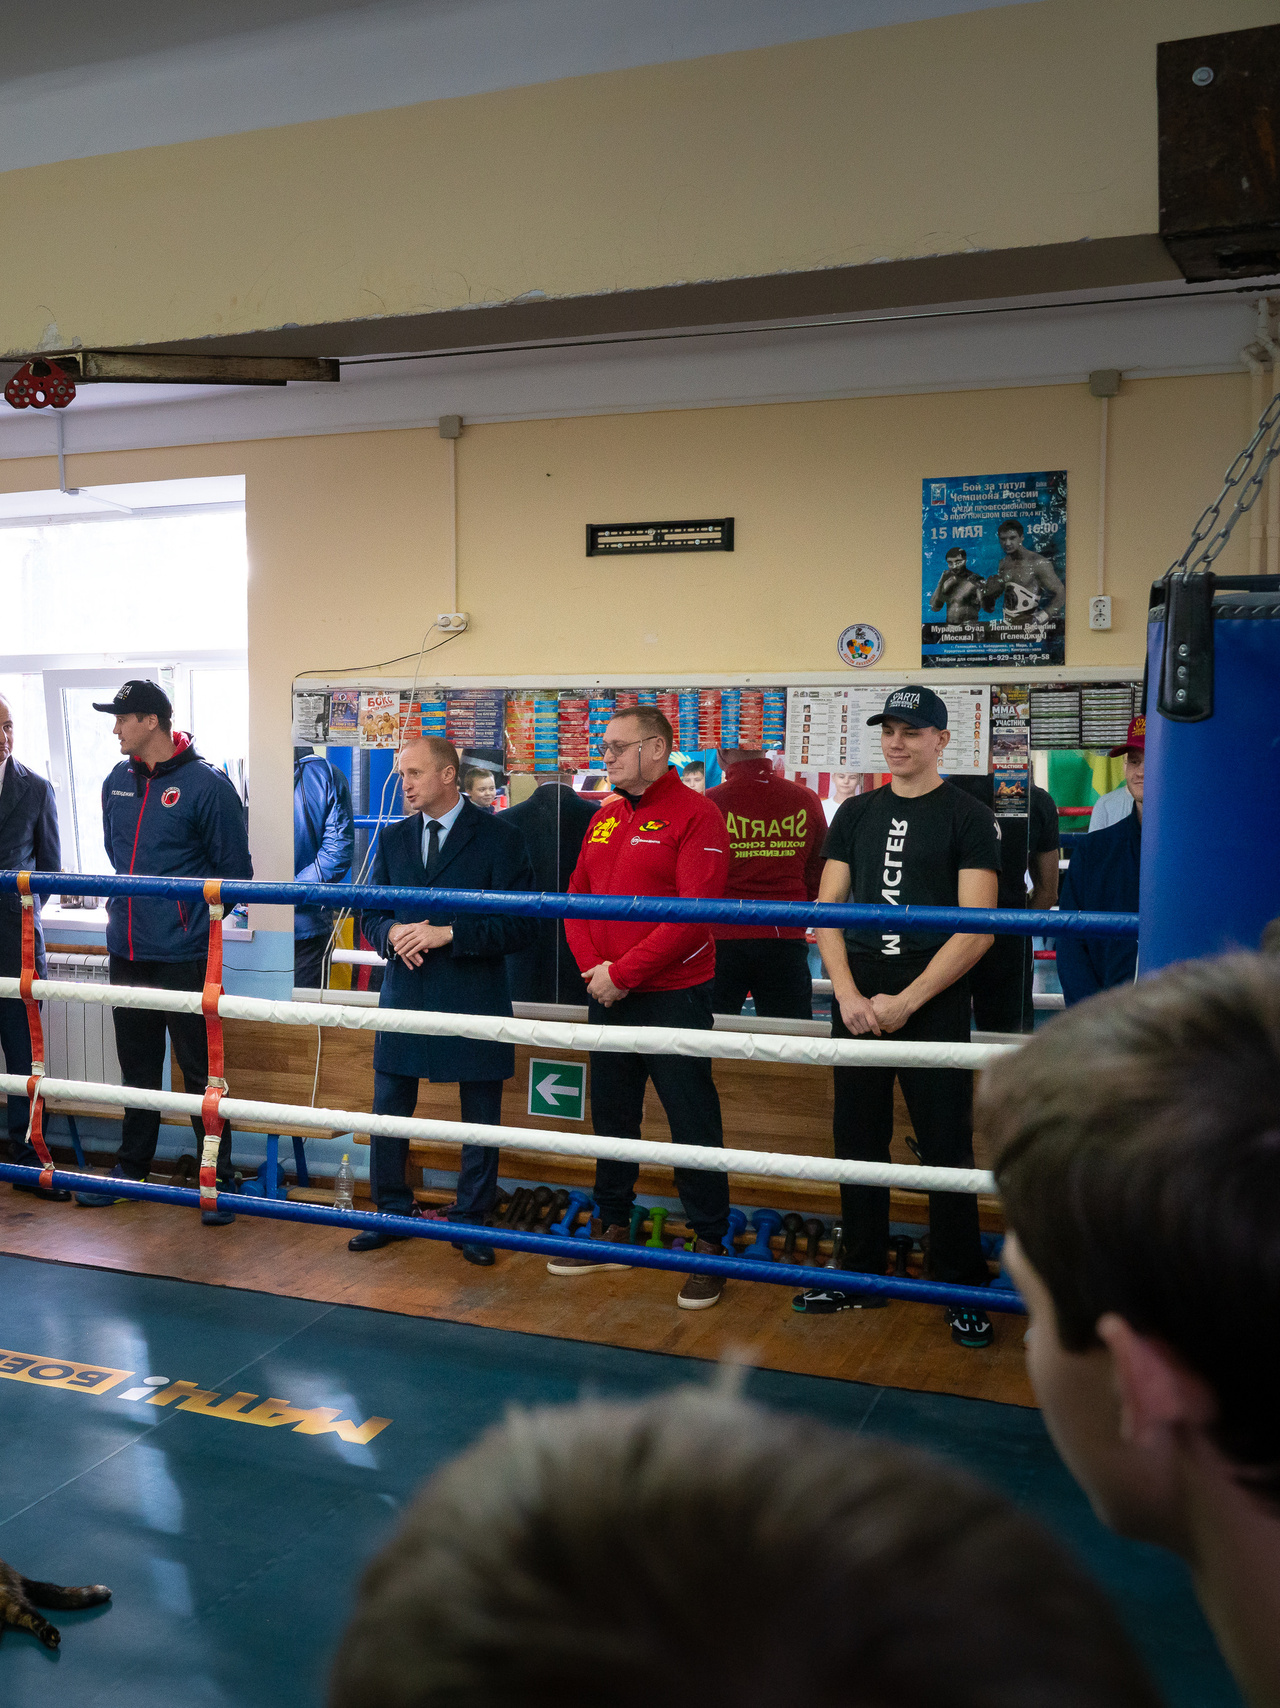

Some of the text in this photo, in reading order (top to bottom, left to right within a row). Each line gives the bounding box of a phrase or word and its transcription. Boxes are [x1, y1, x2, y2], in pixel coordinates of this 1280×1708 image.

[962, 482, 981, 492] Бой
[984, 483, 996, 491] за
[998, 481, 1026, 491] титул
[950, 490, 1039, 502] Чемпиона России
[974, 502, 1037, 512] ПРОФЕССИОНАЛОВ
[930, 527, 948, 540] 15
[952, 525, 983, 539] МАЯ
[964, 624, 985, 632] Фуад
[941, 633, 974, 641] (Москва)
[367, 695, 393, 707] БОКС
[992, 705, 1016, 714] ММА
[995, 719, 1026, 727] УЧАСТНИК
